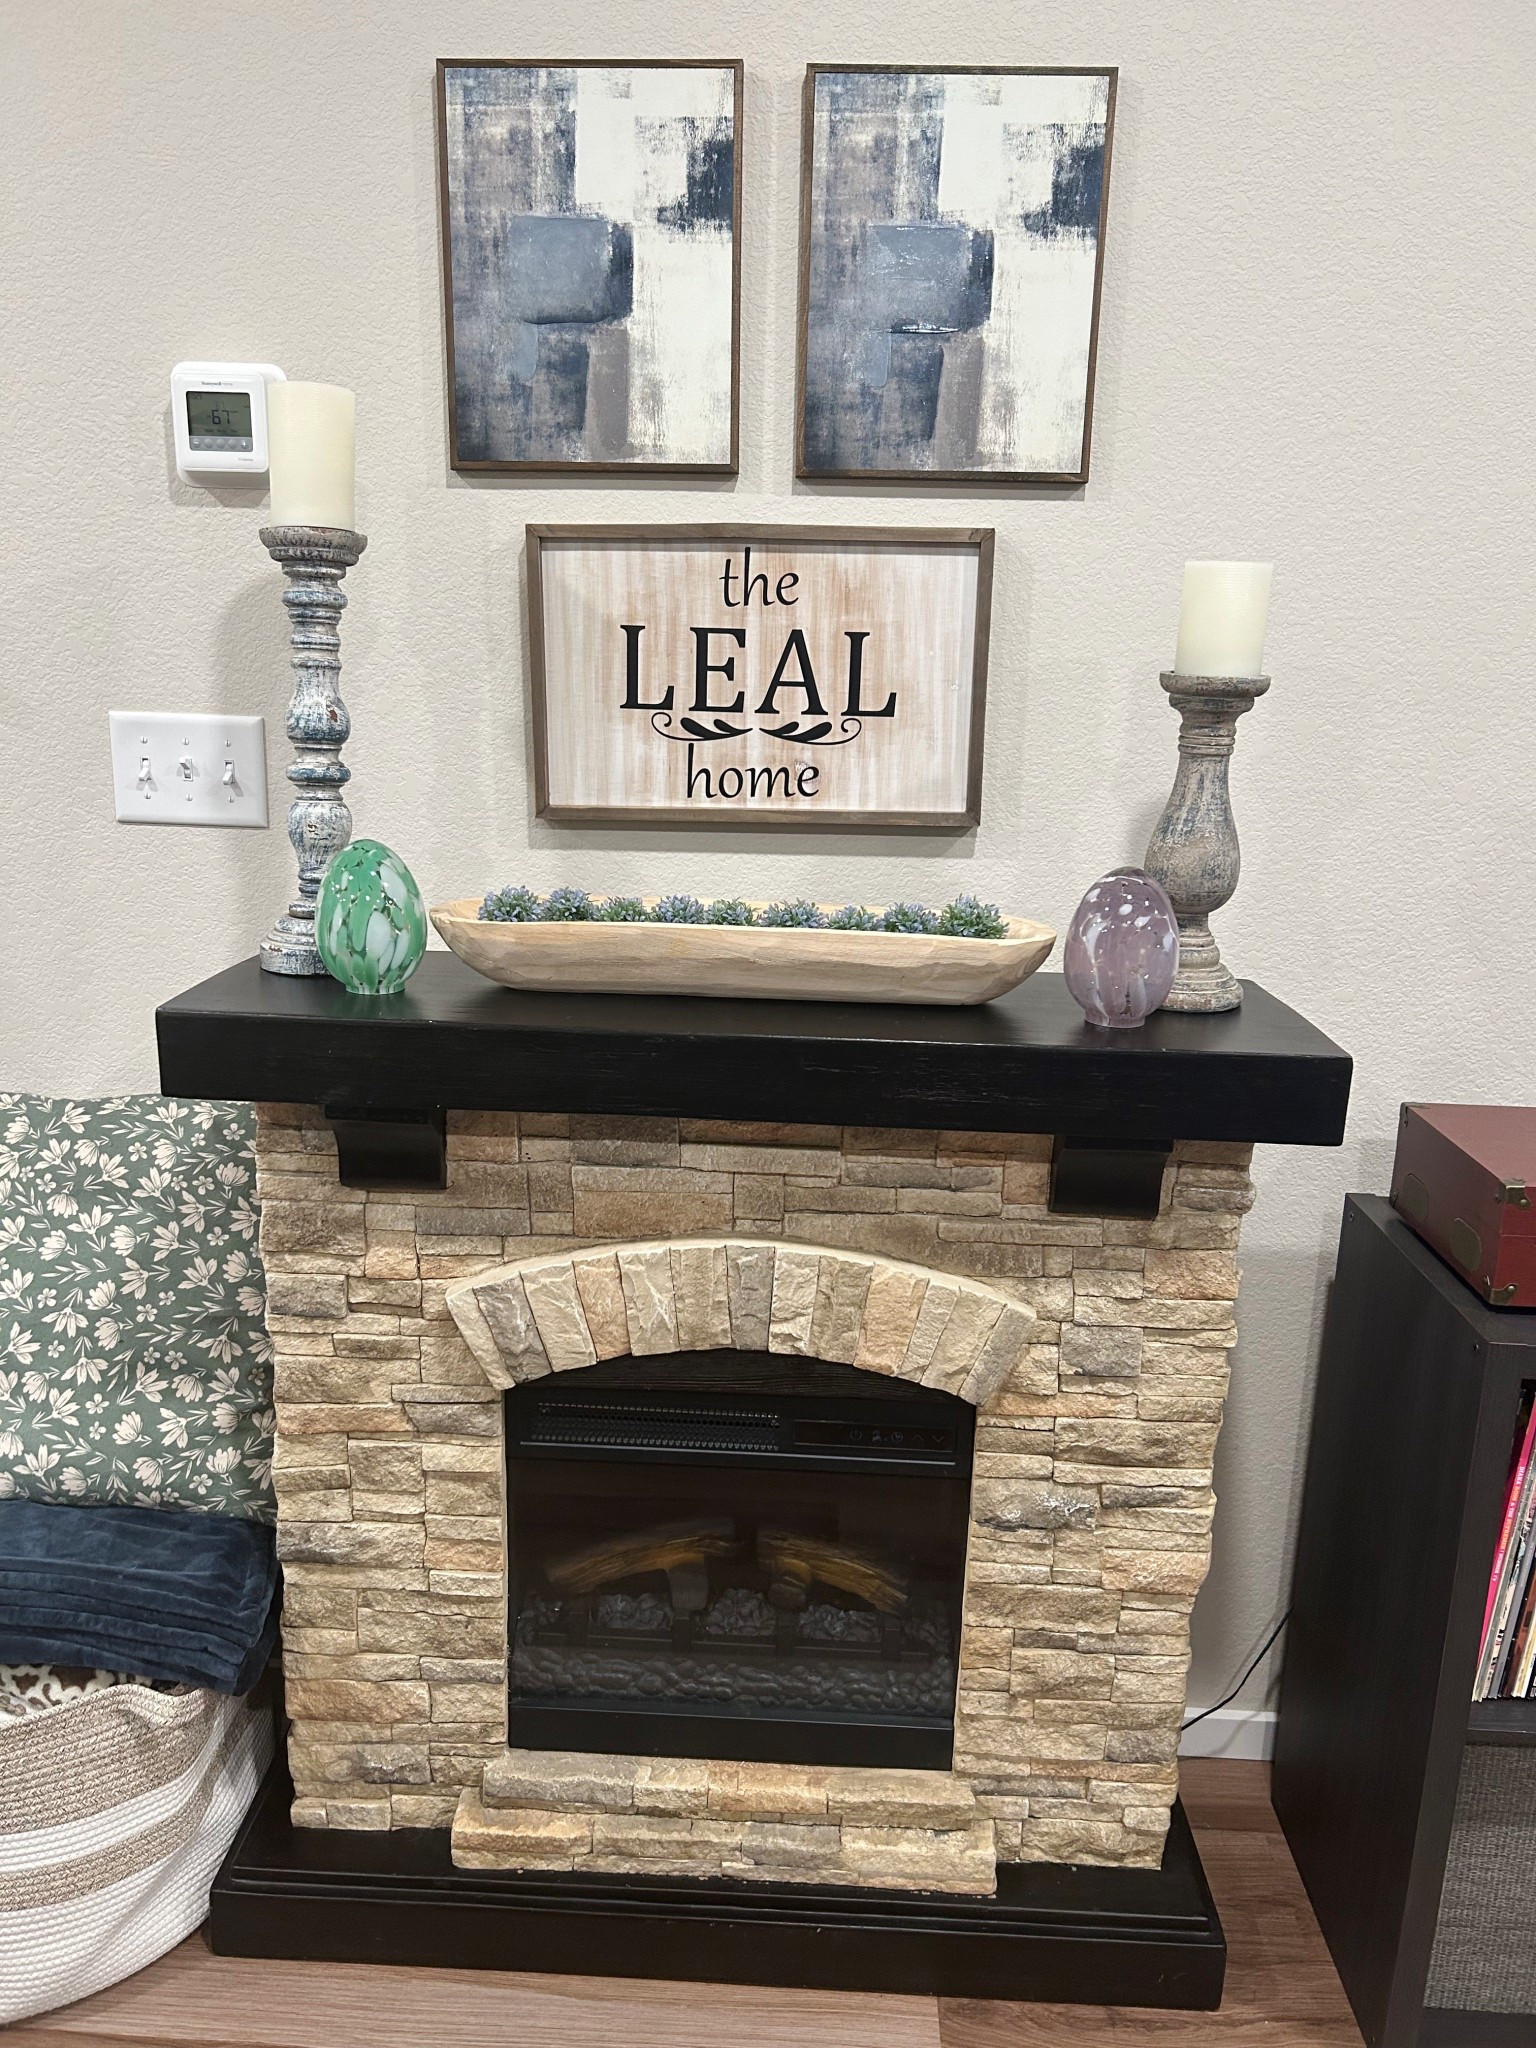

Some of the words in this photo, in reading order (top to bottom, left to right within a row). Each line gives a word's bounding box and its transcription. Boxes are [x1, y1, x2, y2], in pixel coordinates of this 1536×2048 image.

[212, 409, 230, 425] 67
[719, 546, 800, 607] the
[619, 624, 898, 718] LEAL
[687, 742, 821, 799] home
[1516, 1466, 1525, 1485] DIANA
